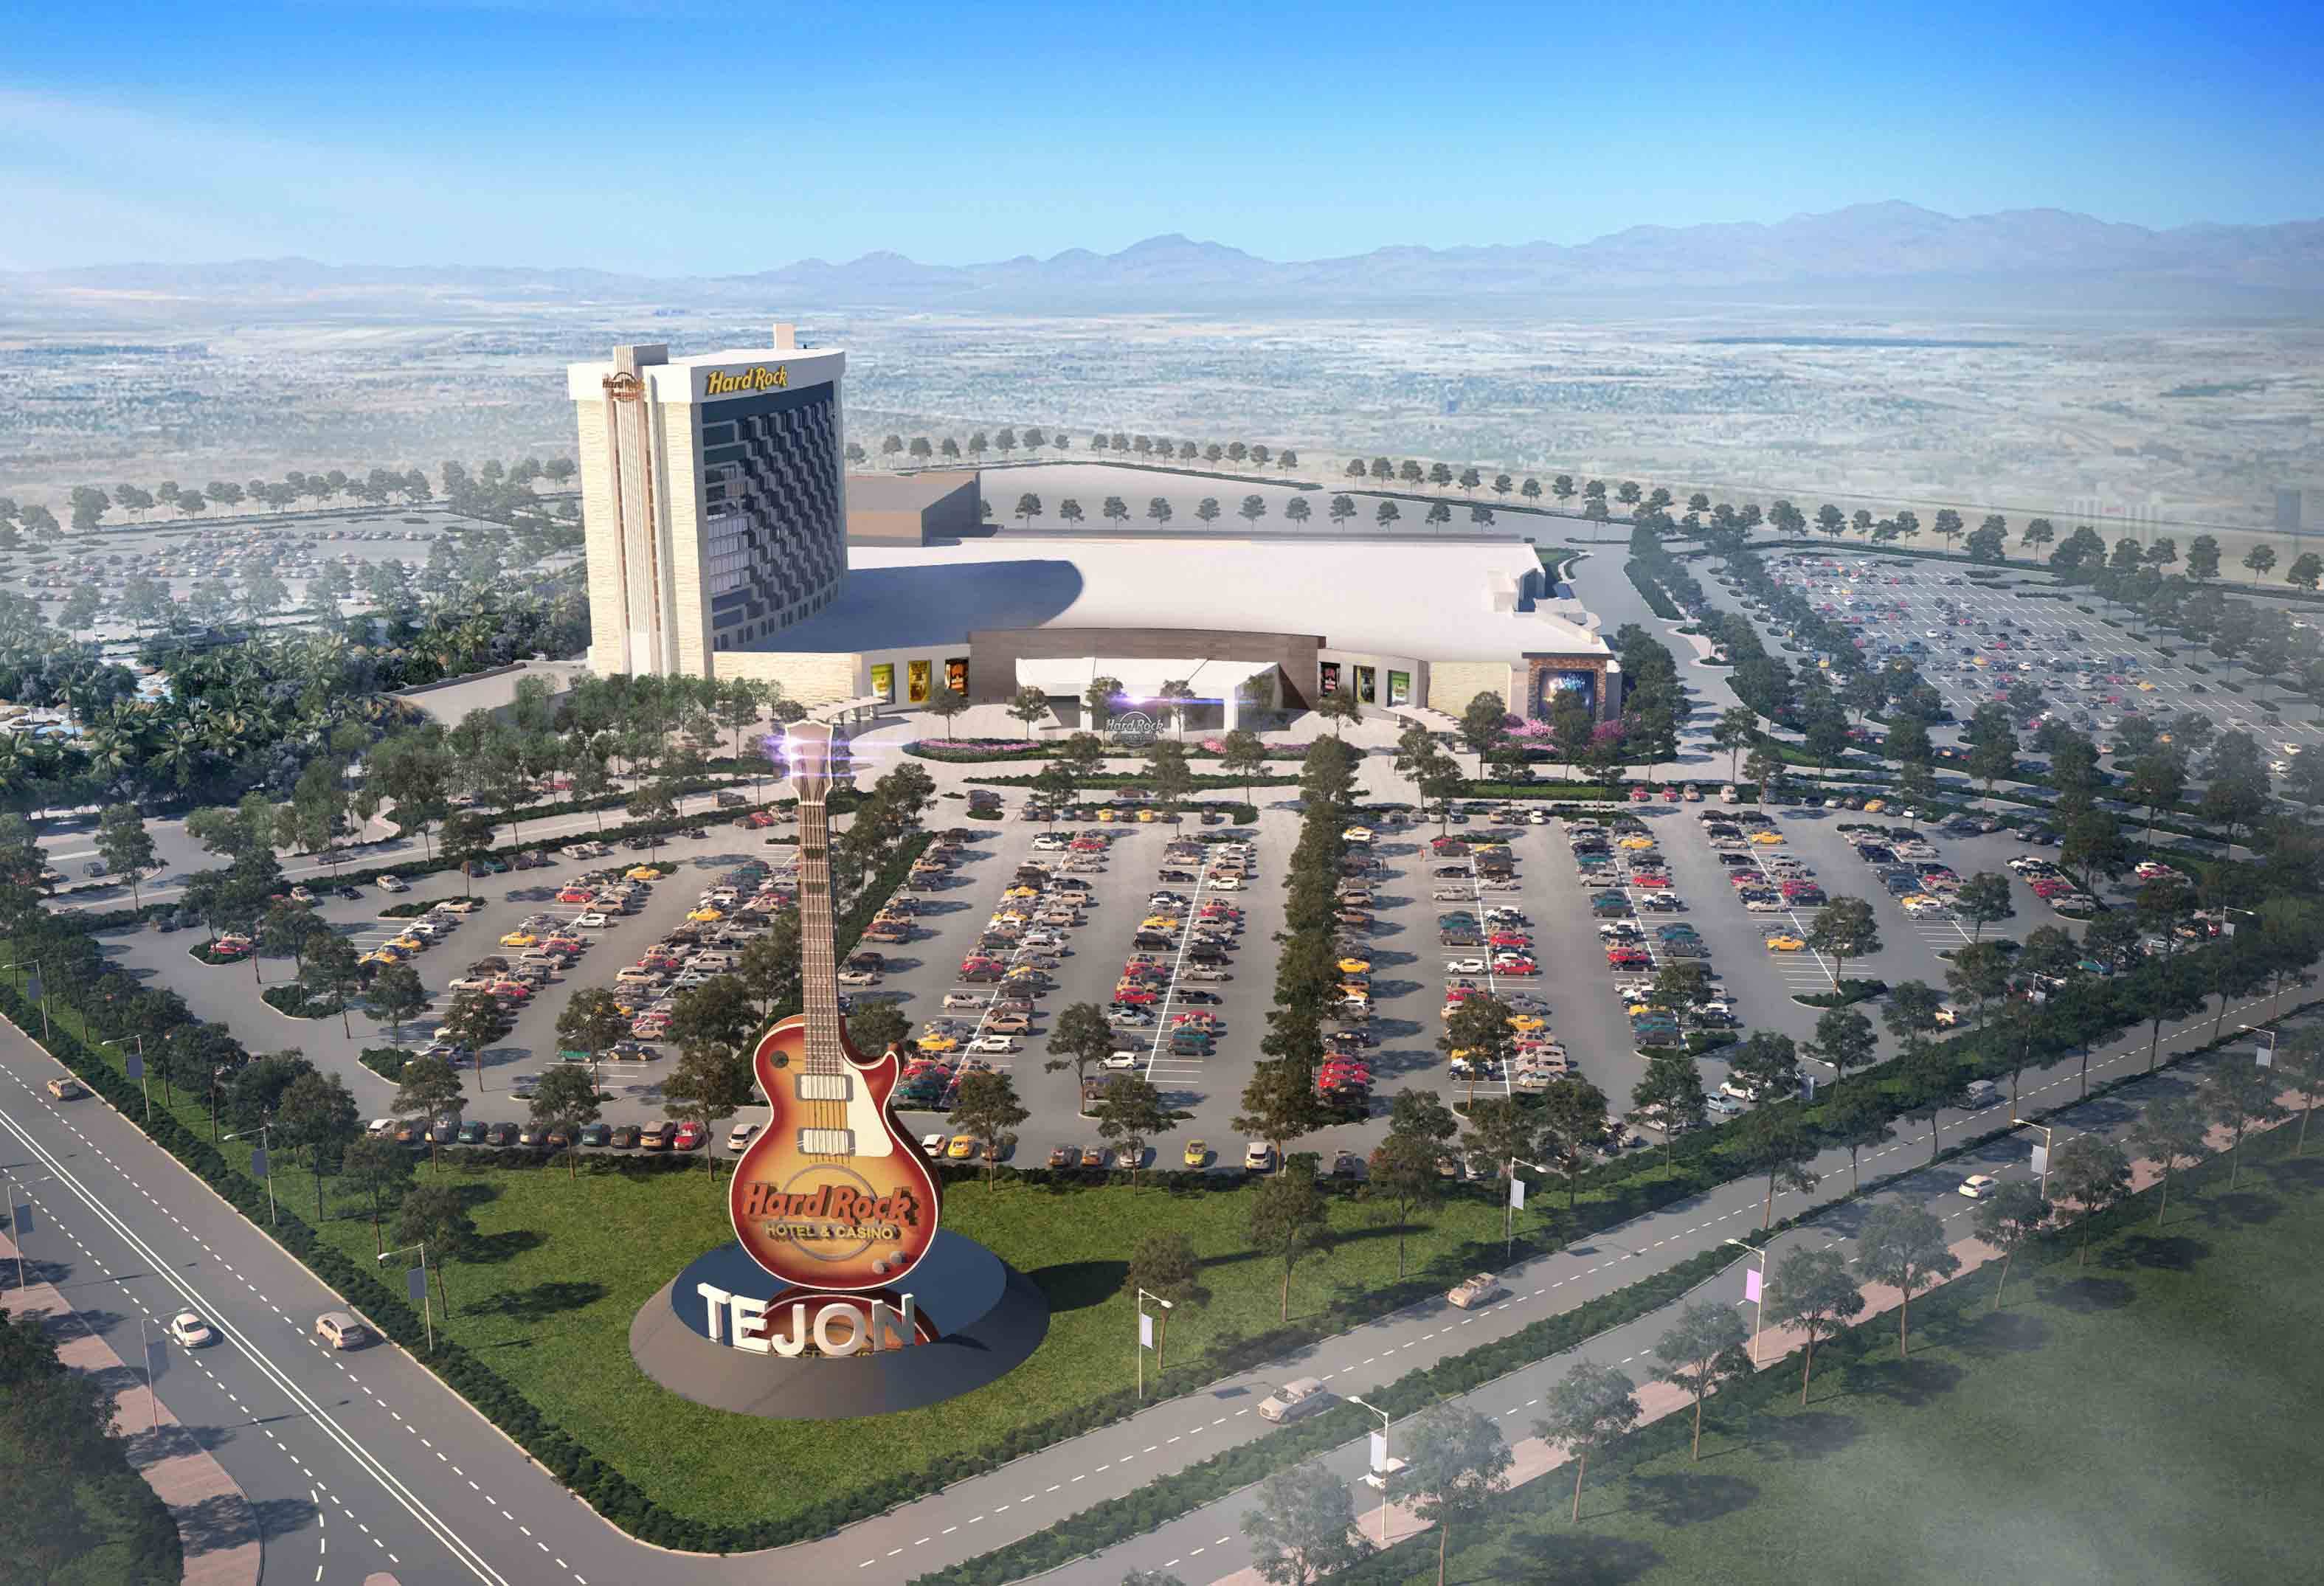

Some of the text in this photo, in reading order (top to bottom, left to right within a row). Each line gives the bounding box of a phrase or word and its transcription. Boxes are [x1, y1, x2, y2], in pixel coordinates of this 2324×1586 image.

[708, 366, 787, 395] Hard Rock
[1106, 719, 1163, 733] Hard Rock
[742, 1182, 910, 1227] Hard Rock
[765, 1225, 894, 1239] HOTEL & CASINO
[697, 1282, 915, 1357] TEJON
